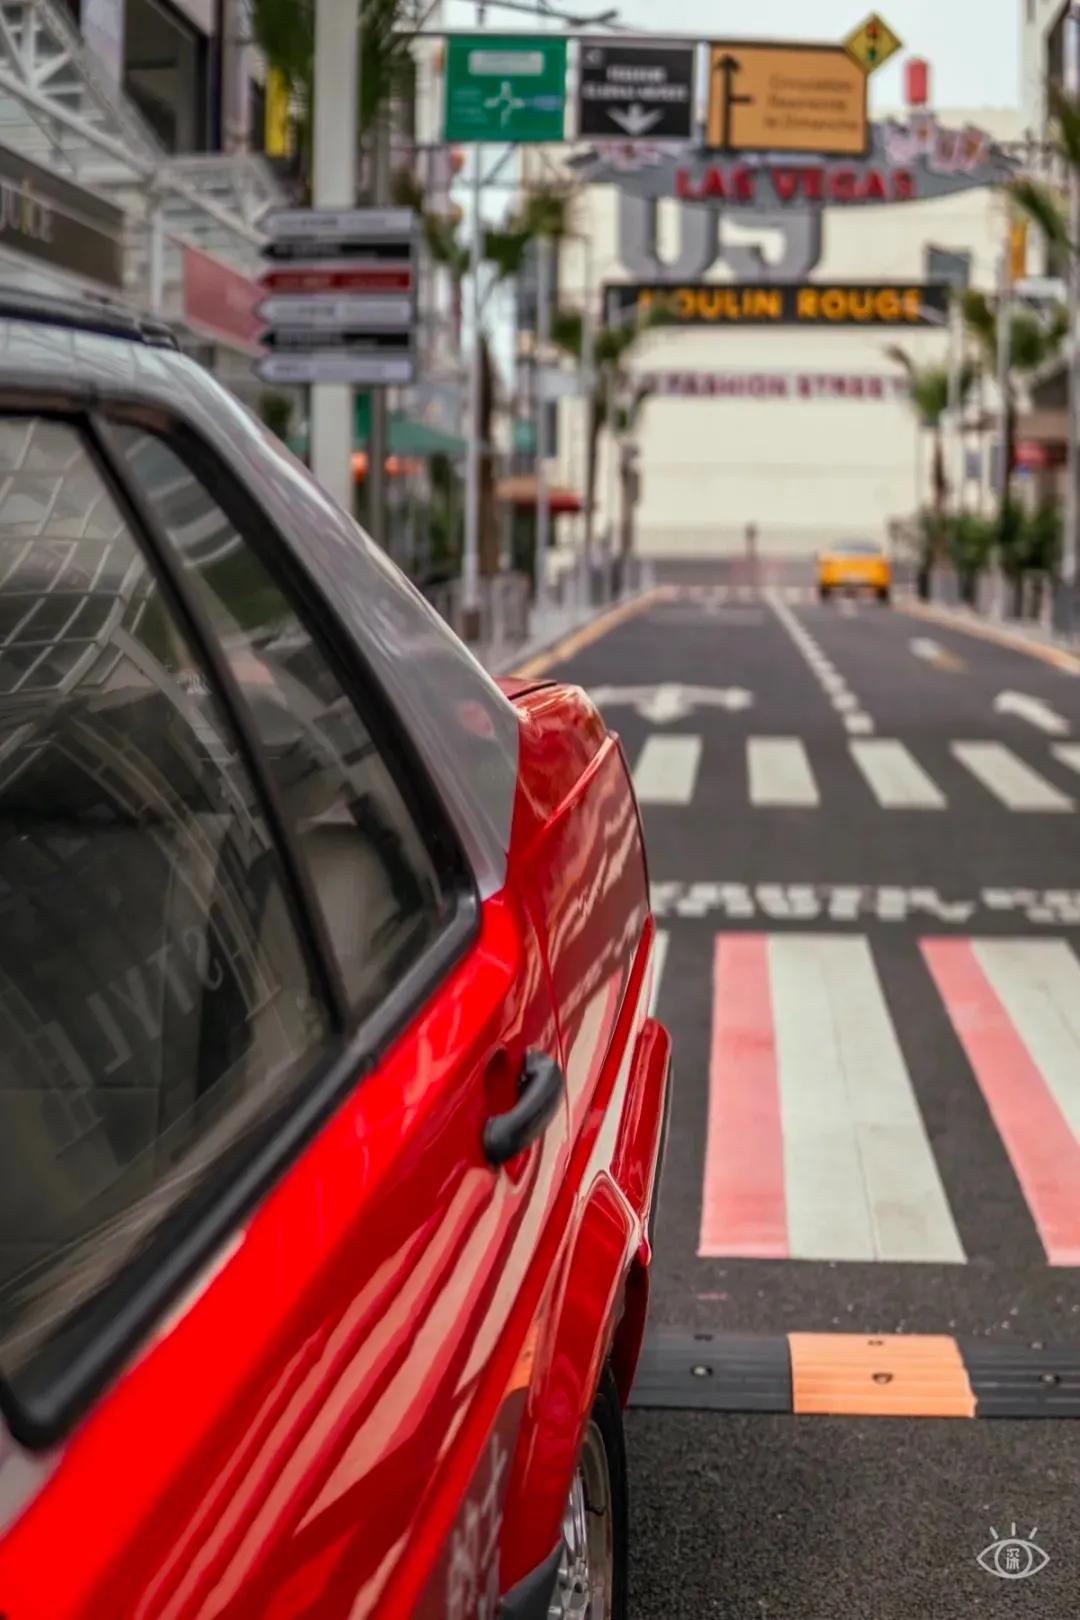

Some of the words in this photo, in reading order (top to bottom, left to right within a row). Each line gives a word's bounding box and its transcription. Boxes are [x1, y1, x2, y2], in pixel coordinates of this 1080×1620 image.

[676, 165, 757, 202] LAS
[769, 165, 916, 202] VEGAS
[797, 287, 920, 321] ROUGE
